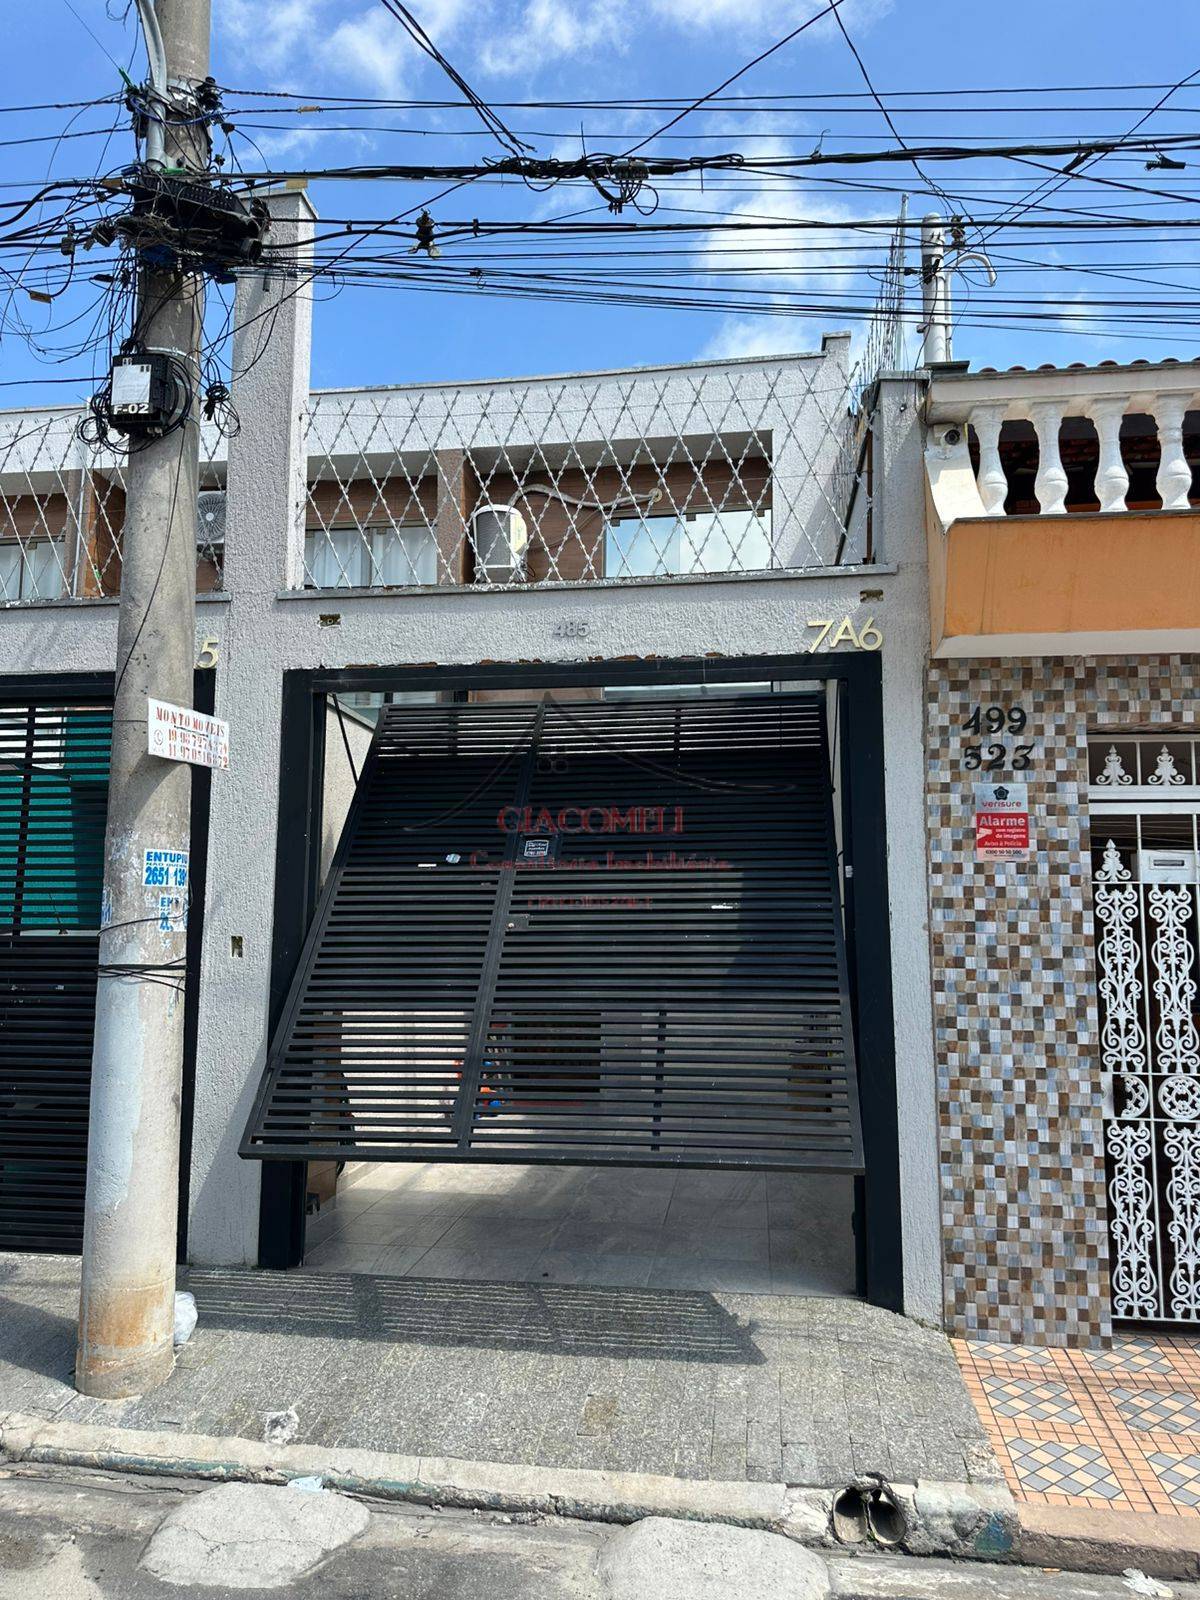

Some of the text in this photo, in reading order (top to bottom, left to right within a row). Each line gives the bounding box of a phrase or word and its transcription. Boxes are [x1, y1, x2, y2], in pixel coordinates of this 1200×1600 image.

[113, 403, 150, 415] F-02
[551, 619, 591, 639] 485
[806, 614, 883, 654] 7A6
[962, 705, 1027, 736] 499
[964, 742, 1035, 772] 523
[979, 815, 1027, 827] Alarme
